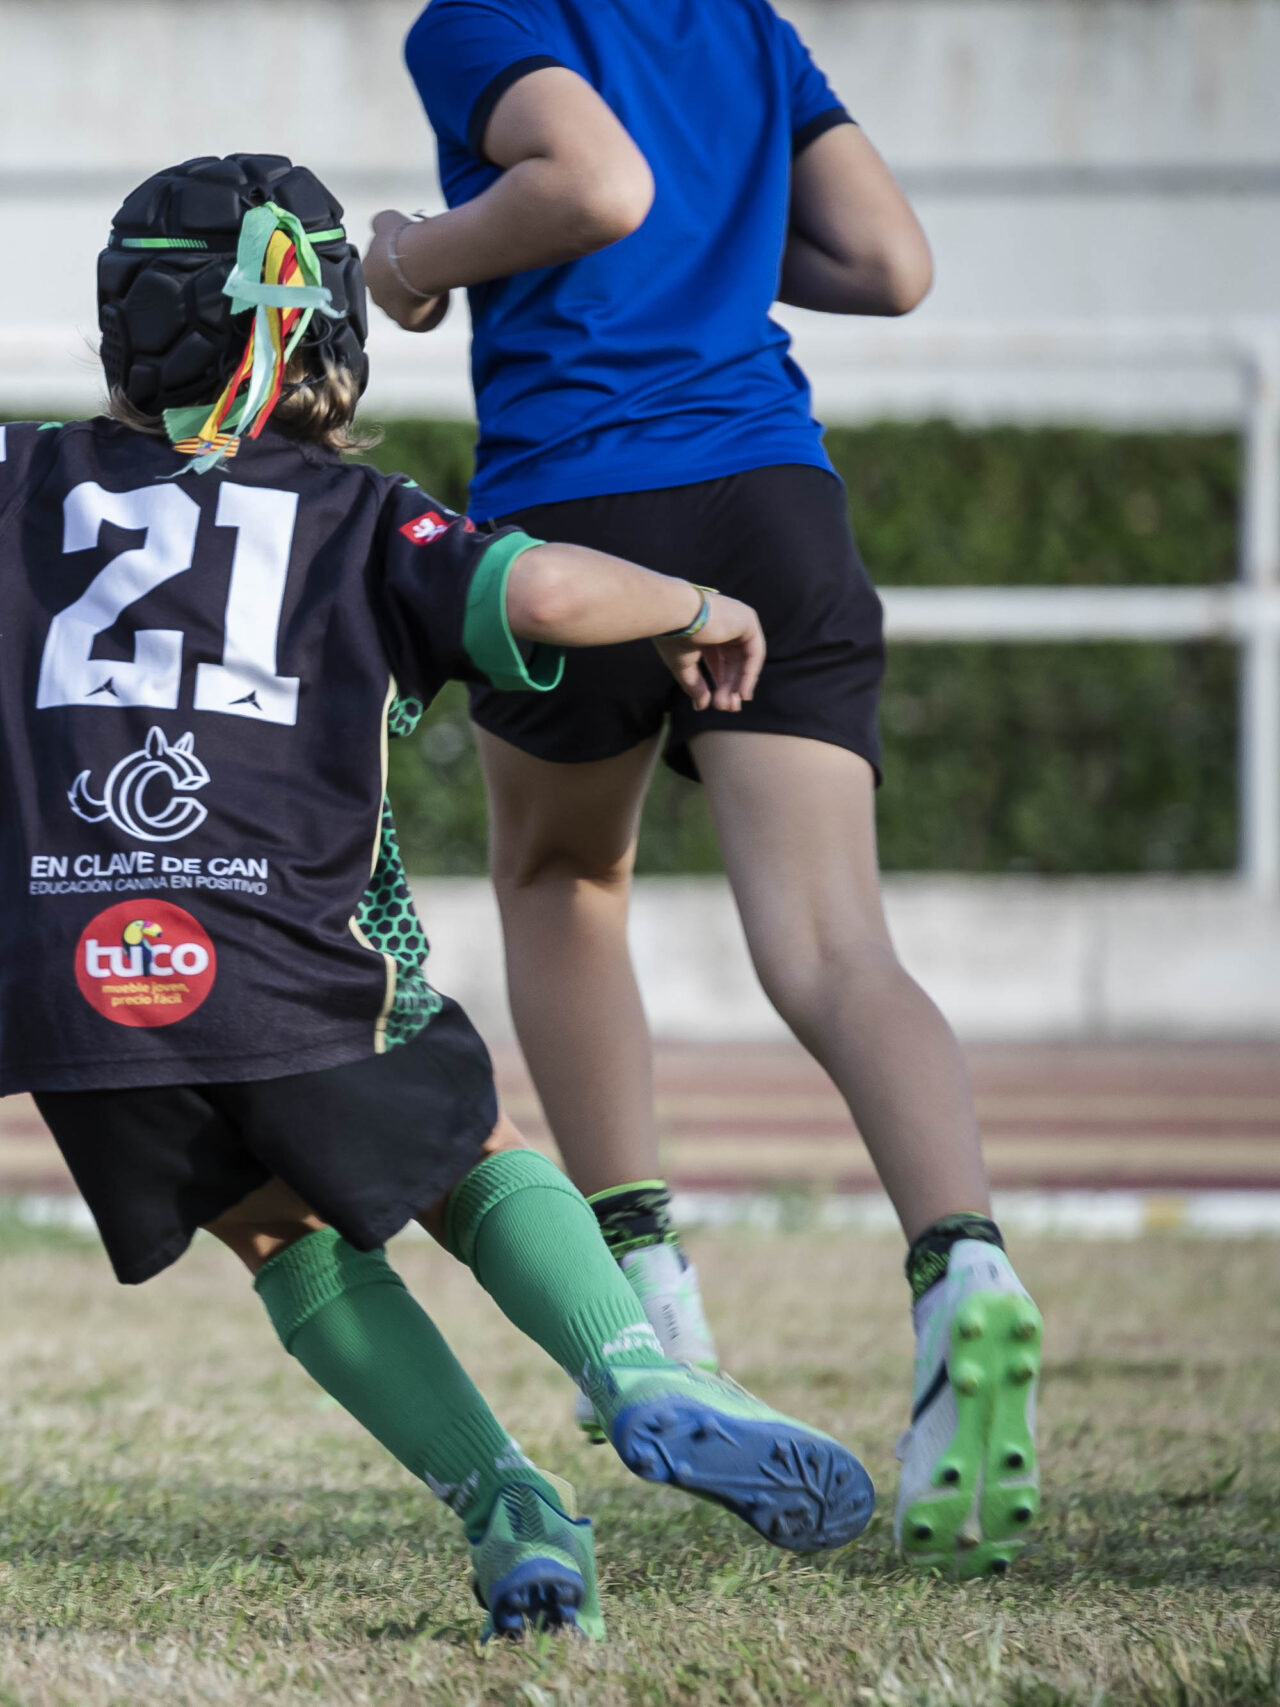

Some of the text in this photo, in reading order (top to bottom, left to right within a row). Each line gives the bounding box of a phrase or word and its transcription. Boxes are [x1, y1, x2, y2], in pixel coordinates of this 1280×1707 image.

[35, 480, 300, 726] 21
[30, 851, 268, 879] EN CLAVE DE CAN
[115, 876, 169, 892] CANINA
[170, 875, 193, 889] EN
[195, 875, 268, 896] POSITIVO
[85, 938, 209, 978] tuco
